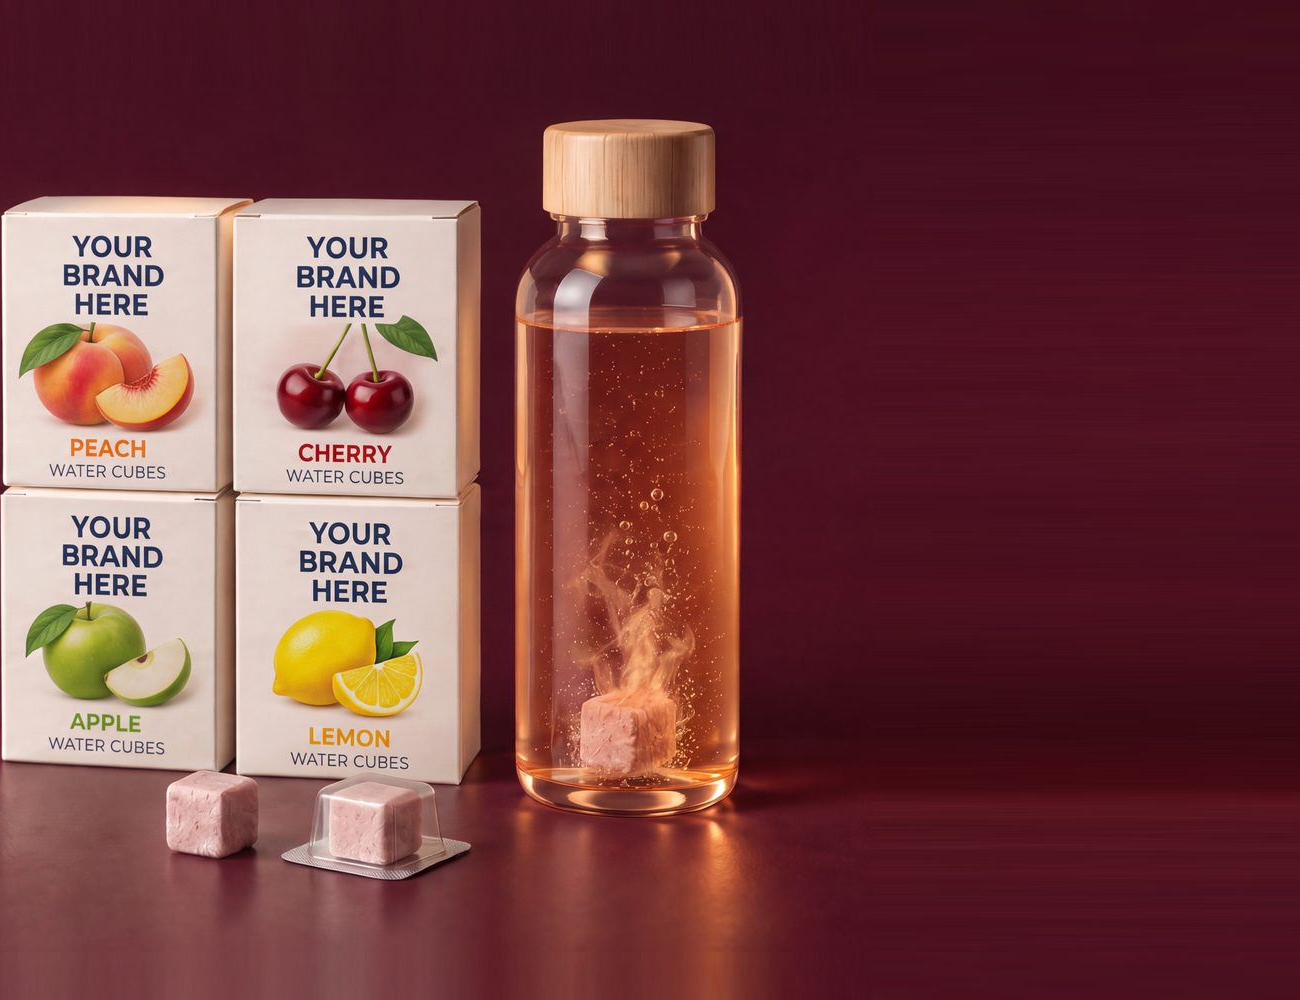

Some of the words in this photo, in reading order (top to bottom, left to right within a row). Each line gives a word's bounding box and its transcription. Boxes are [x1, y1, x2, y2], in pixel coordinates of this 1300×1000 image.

[71, 235, 153, 259] YOUR
[306, 236, 389, 260] YOUR
[63, 264, 165, 288] BRAND
[296, 265, 401, 289] BRAND
[75, 293, 149, 317] HERE
[310, 295, 385, 319] HERE
[70, 438, 147, 459] PEACH
[298, 443, 393, 464] CHERRY
[49, 463, 107, 479] WATER
[111, 465, 166, 480] CUBES
[286, 468, 344, 484] WATER
[349, 469, 405, 485] CUBES
[70, 515, 151, 540] YOUR
[308, 521, 392, 546] YOUR
[62, 544, 164, 569] BRAND
[299, 550, 404, 575] BRAND
[74, 573, 148, 598] HERE
[312, 579, 388, 604] HERE
[70, 712, 141, 733] APPLE
[48, 736, 105, 753] WATER
[110, 739, 165, 756] CUBES
[308, 726, 391, 749] LEMON
[290, 751, 348, 768] WATER
[353, 753, 409, 770] CUBES
